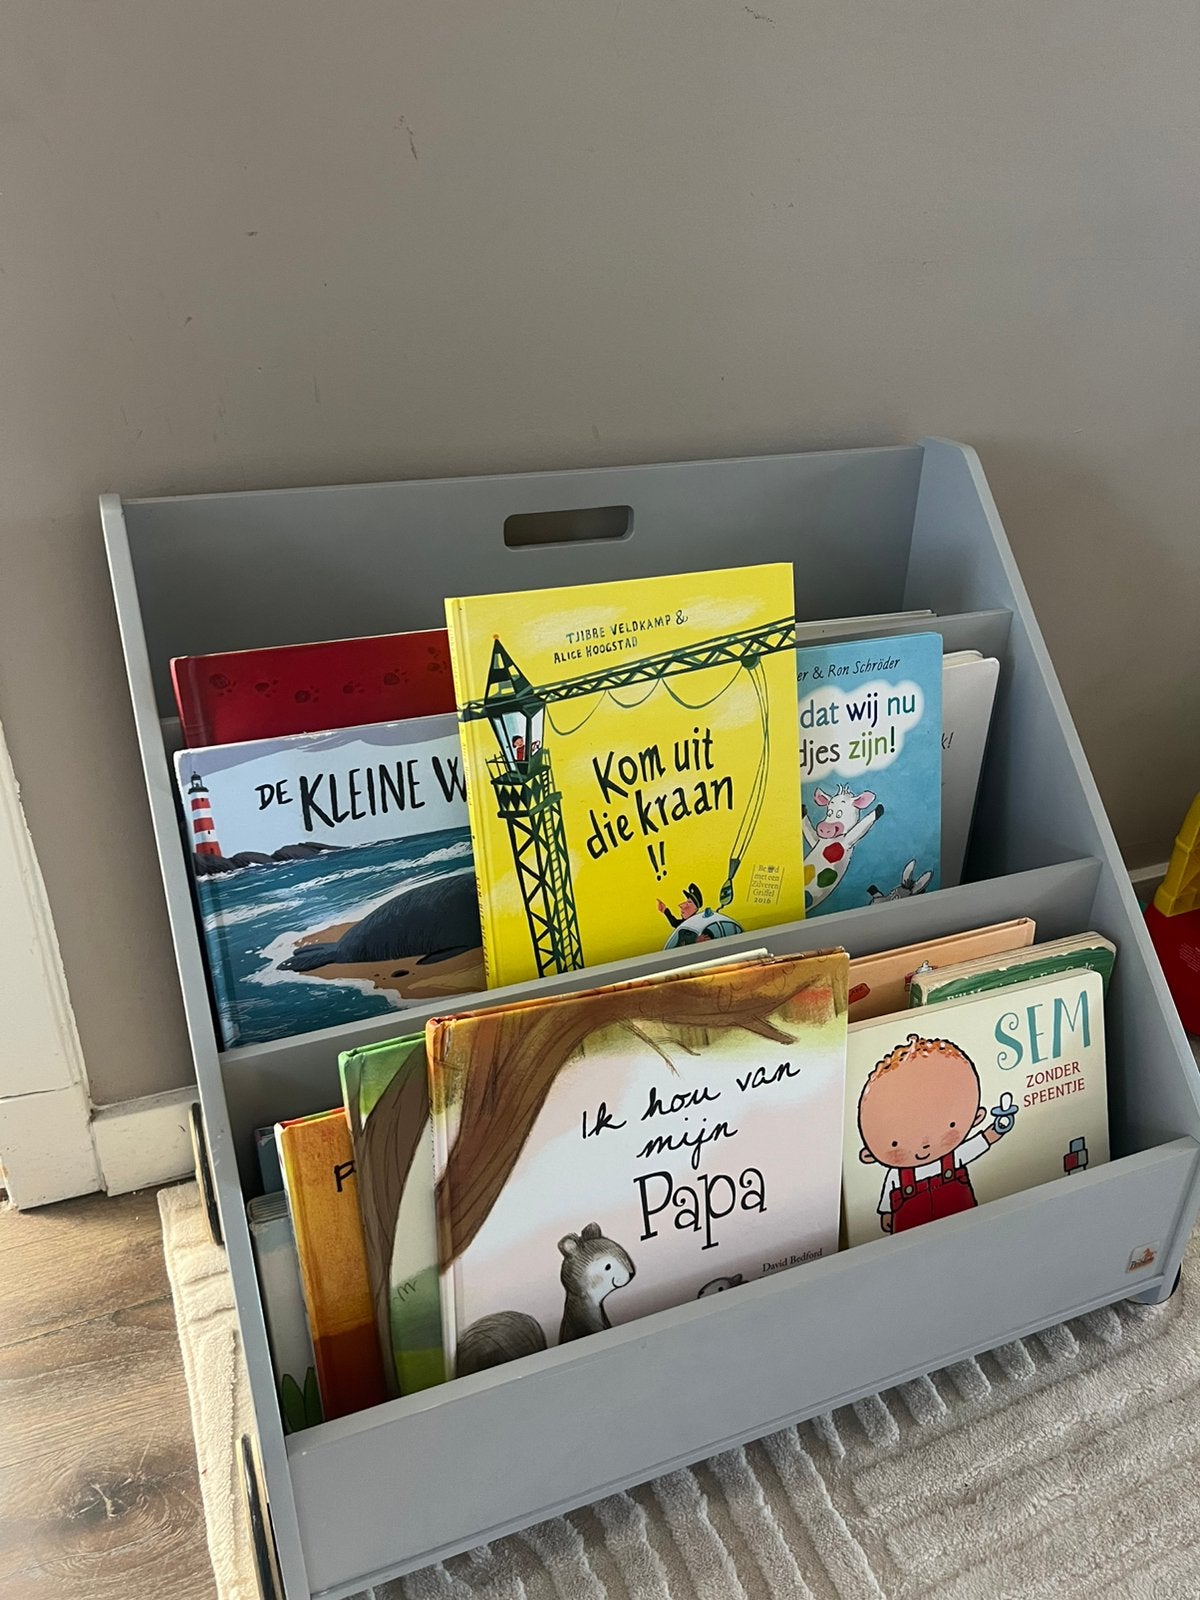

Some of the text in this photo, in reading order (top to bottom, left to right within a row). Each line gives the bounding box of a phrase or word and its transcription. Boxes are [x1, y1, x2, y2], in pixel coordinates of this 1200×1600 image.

[610, 614, 671, 636] VELDKAMP
[675, 609, 688, 625] &
[554, 636, 638, 664] ALICE HOOGSTAD
[812, 666, 824, 679] &
[828, 664, 850, 678] Ron
[853, 656, 900, 675] Schröder
[800, 692, 916, 729] dat wij nu
[592, 727, 714, 804] Kom uit
[848, 726, 895, 767] zijn!
[254, 779, 293, 811] DE
[299, 759, 426, 832] KLEINE
[586, 776, 734, 860] die kraan
[994, 990, 1091, 1071] SEM
[1023, 1078, 1085, 1108] SPEENTJE
[1025, 1061, 1081, 1088] ZONDER
[581, 1061, 801, 1139] Ik hou van
[636, 1117, 738, 1170] mijn
[633, 1167, 768, 1251] Papa
[763, 1247, 823, 1272] David Bedford
